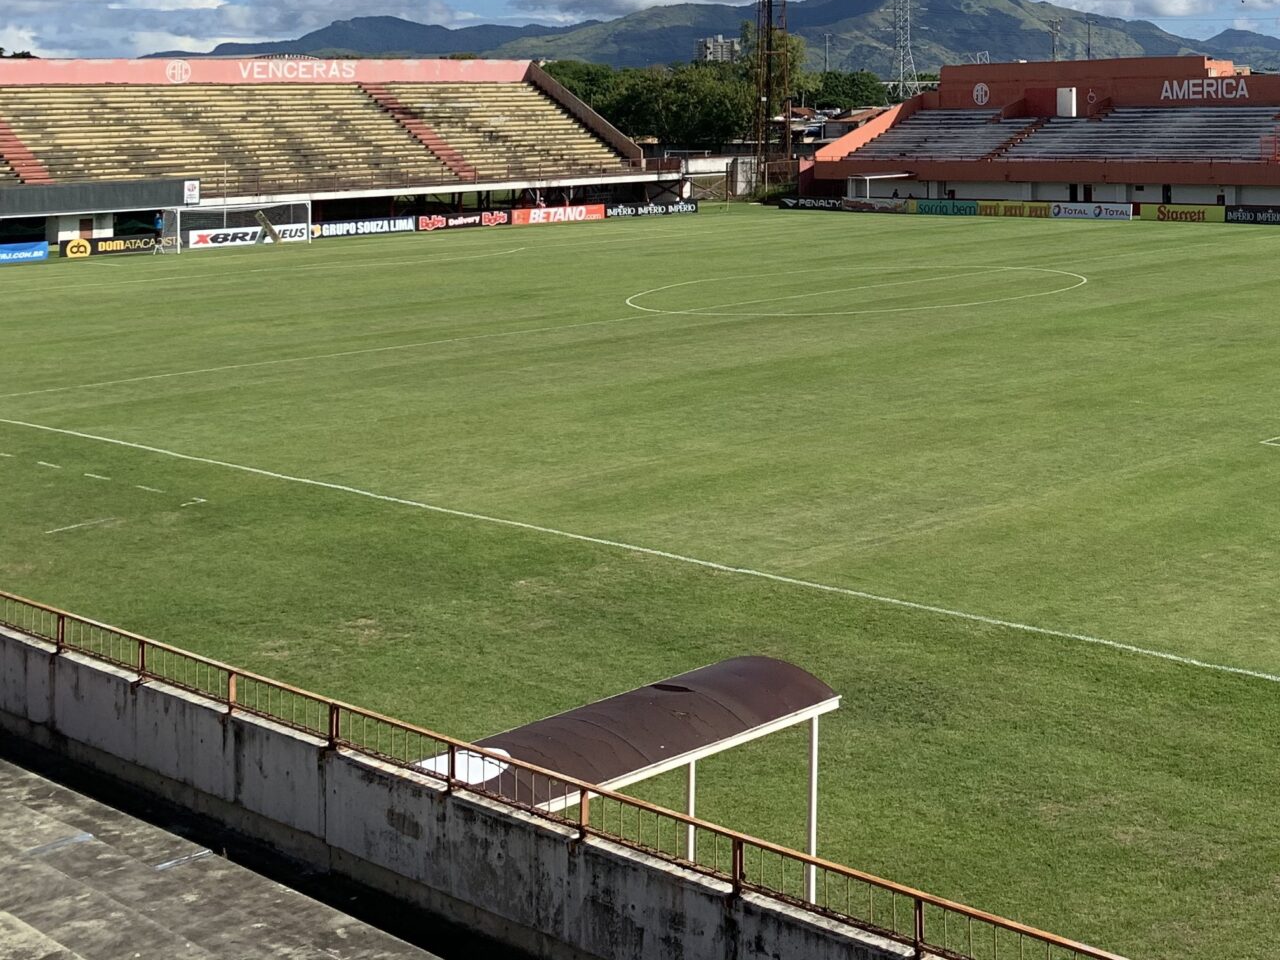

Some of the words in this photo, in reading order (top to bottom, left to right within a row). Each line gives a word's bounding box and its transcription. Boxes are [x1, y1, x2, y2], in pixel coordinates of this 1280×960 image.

[238, 60, 356, 79] VENCERÁS
[1160, 78, 1249, 100] AMERICA
[799, 199, 841, 208] PENALTY
[953, 201, 976, 216] bem
[322, 223, 356, 236] GRUPO
[358, 220, 389, 234] SOUZA
[390, 218, 414, 231] LIMA
[449, 216, 480, 227] Delivery
[192, 231, 258, 244] XBRI
[0, 251, 44, 260] RJ.COM.BR
